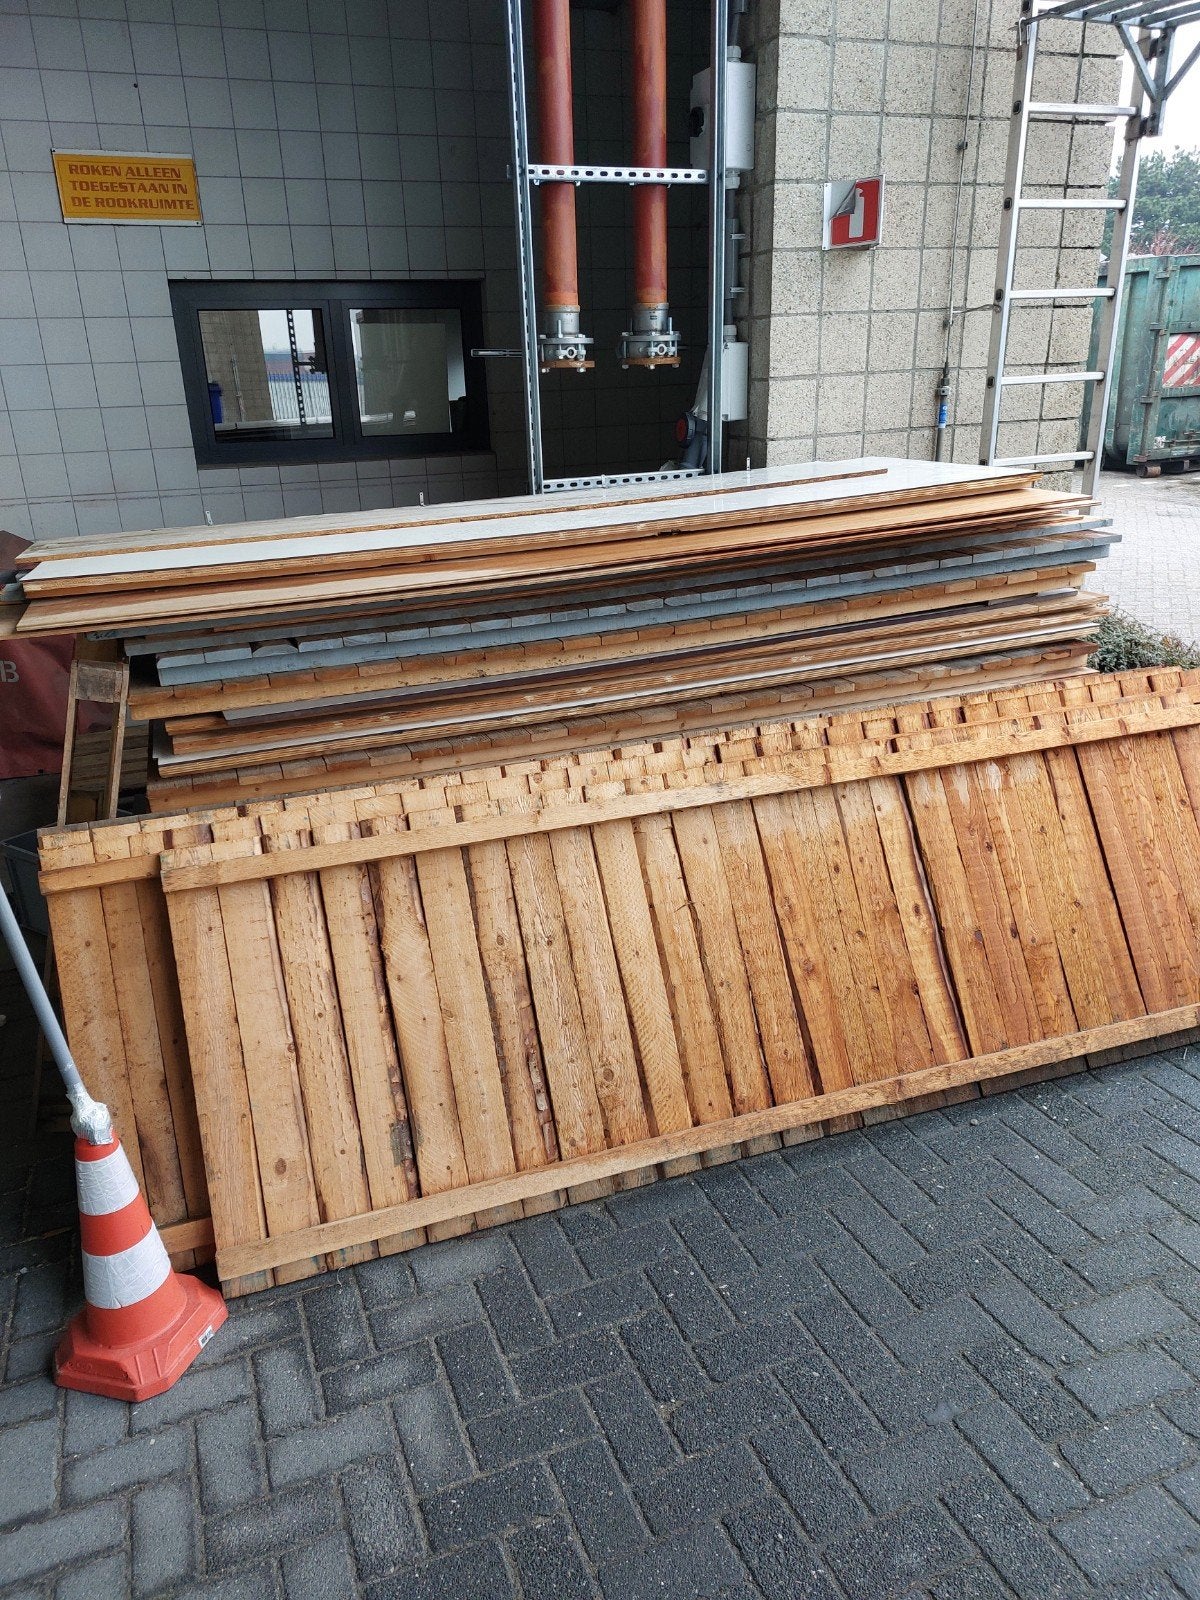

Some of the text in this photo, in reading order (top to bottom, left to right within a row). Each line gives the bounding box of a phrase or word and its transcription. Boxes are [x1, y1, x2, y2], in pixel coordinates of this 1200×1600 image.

[69, 165, 181, 179] ROKEN ALLEEN
[69, 181, 188, 194] TOEGESTAAN IN
[71, 197, 195, 210] DE ROOKRUIMTE
